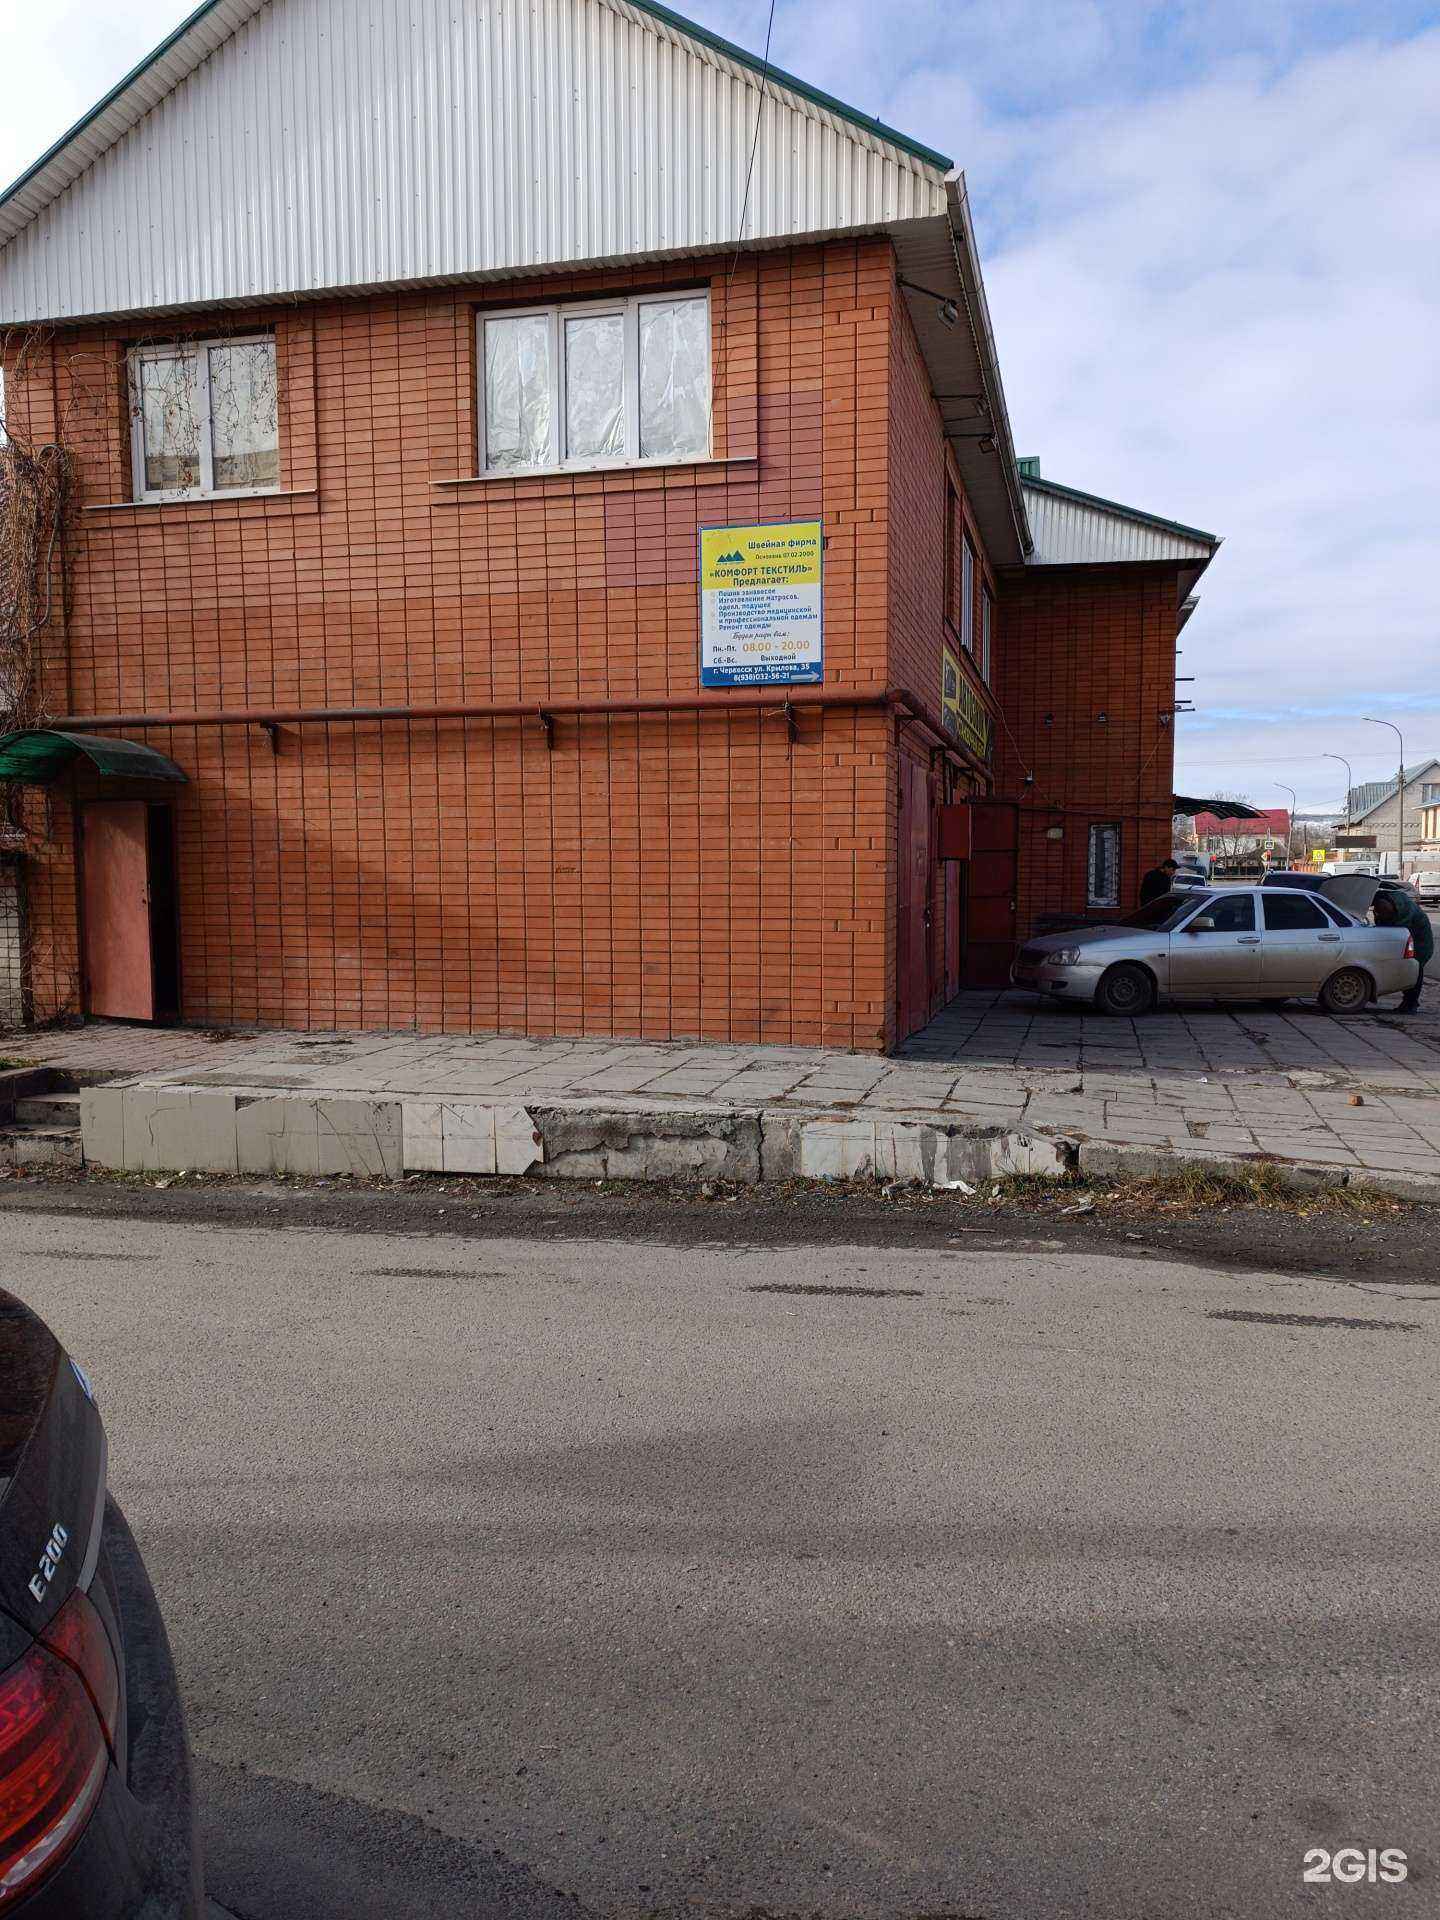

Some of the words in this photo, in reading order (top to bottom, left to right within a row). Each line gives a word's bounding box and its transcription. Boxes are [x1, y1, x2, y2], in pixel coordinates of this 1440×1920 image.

[748, 540, 785, 550] Швейная
[788, 538, 816, 548] фирма
[710, 567, 758, 578] «КОМФОРТ
[760, 564, 812, 574] ТЕКСТИЛЬ»
[733, 576, 790, 587] Предлагает:
[718, 596, 765, 604] Изготовление
[718, 610, 766, 618] Производство
[766, 608, 812, 616] медицинской
[724, 615, 788, 625] профессиональной
[742, 642, 772, 652] 08.00
[782, 640, 810, 650] 20.00
[760, 653, 796, 662] Выходной
